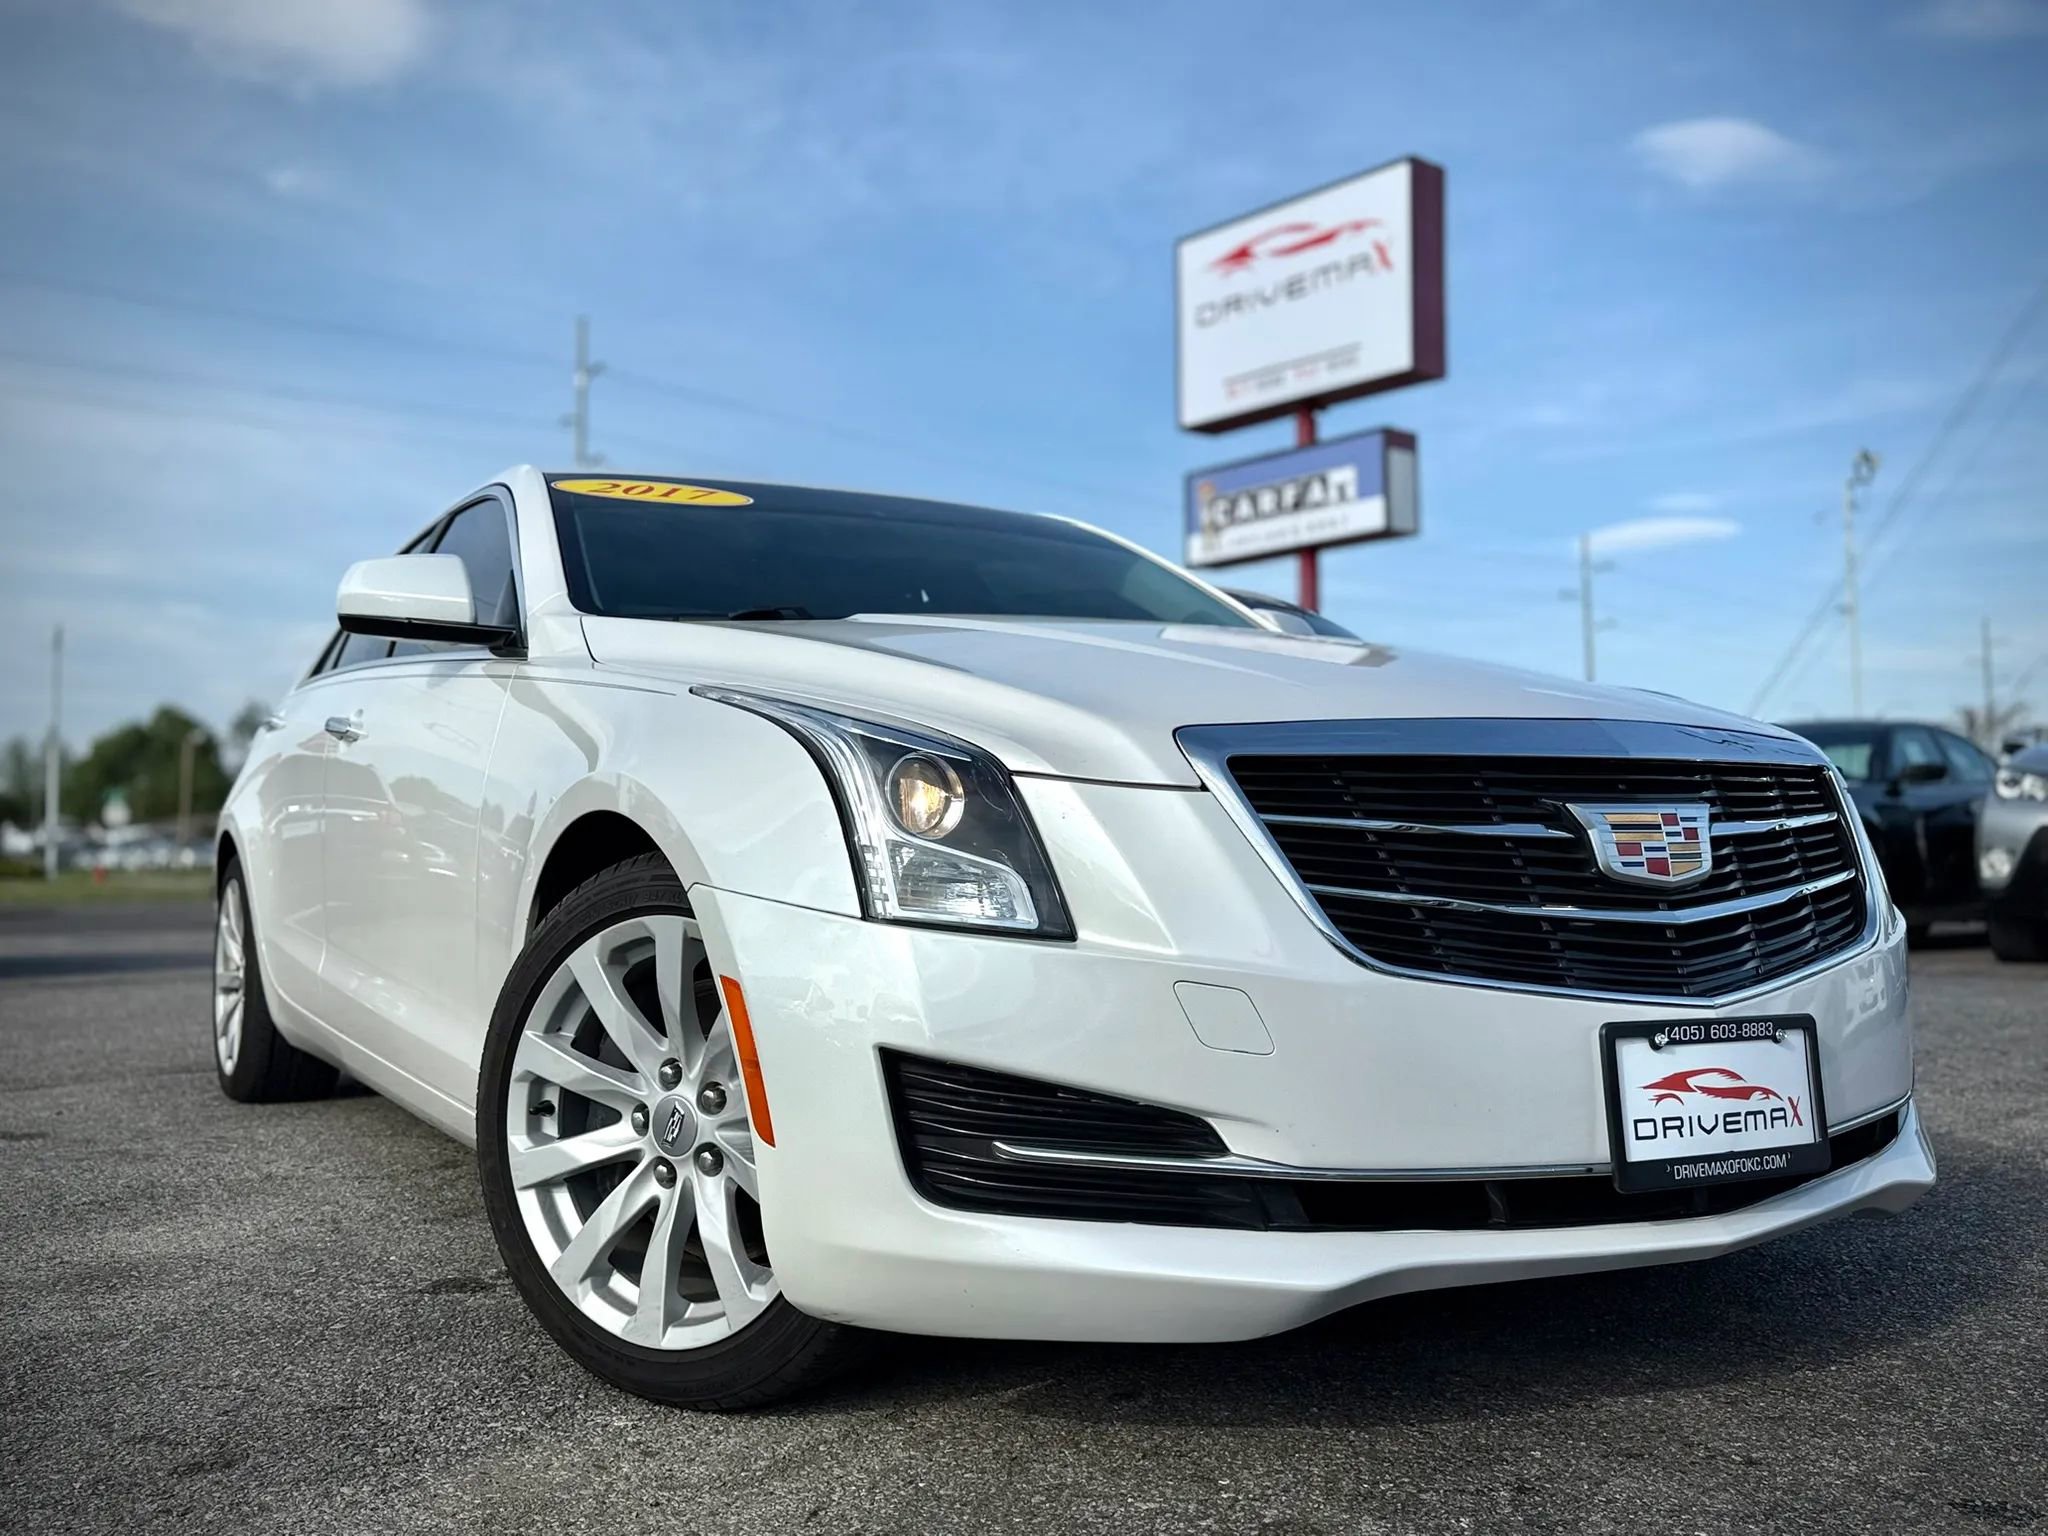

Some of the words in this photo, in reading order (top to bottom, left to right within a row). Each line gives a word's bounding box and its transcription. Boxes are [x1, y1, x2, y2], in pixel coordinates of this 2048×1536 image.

[1195, 239, 1392, 329] DRIVEMAX
[587, 482, 719, 500] 2017
[1665, 1025, 1704, 1041] (405)
[1710, 1022, 1773, 1039] 603-8883
[1633, 1096, 1803, 1141] DRIVEMAX
[1673, 1154, 1787, 1180] DRIVEMAXOFOKC.COM
